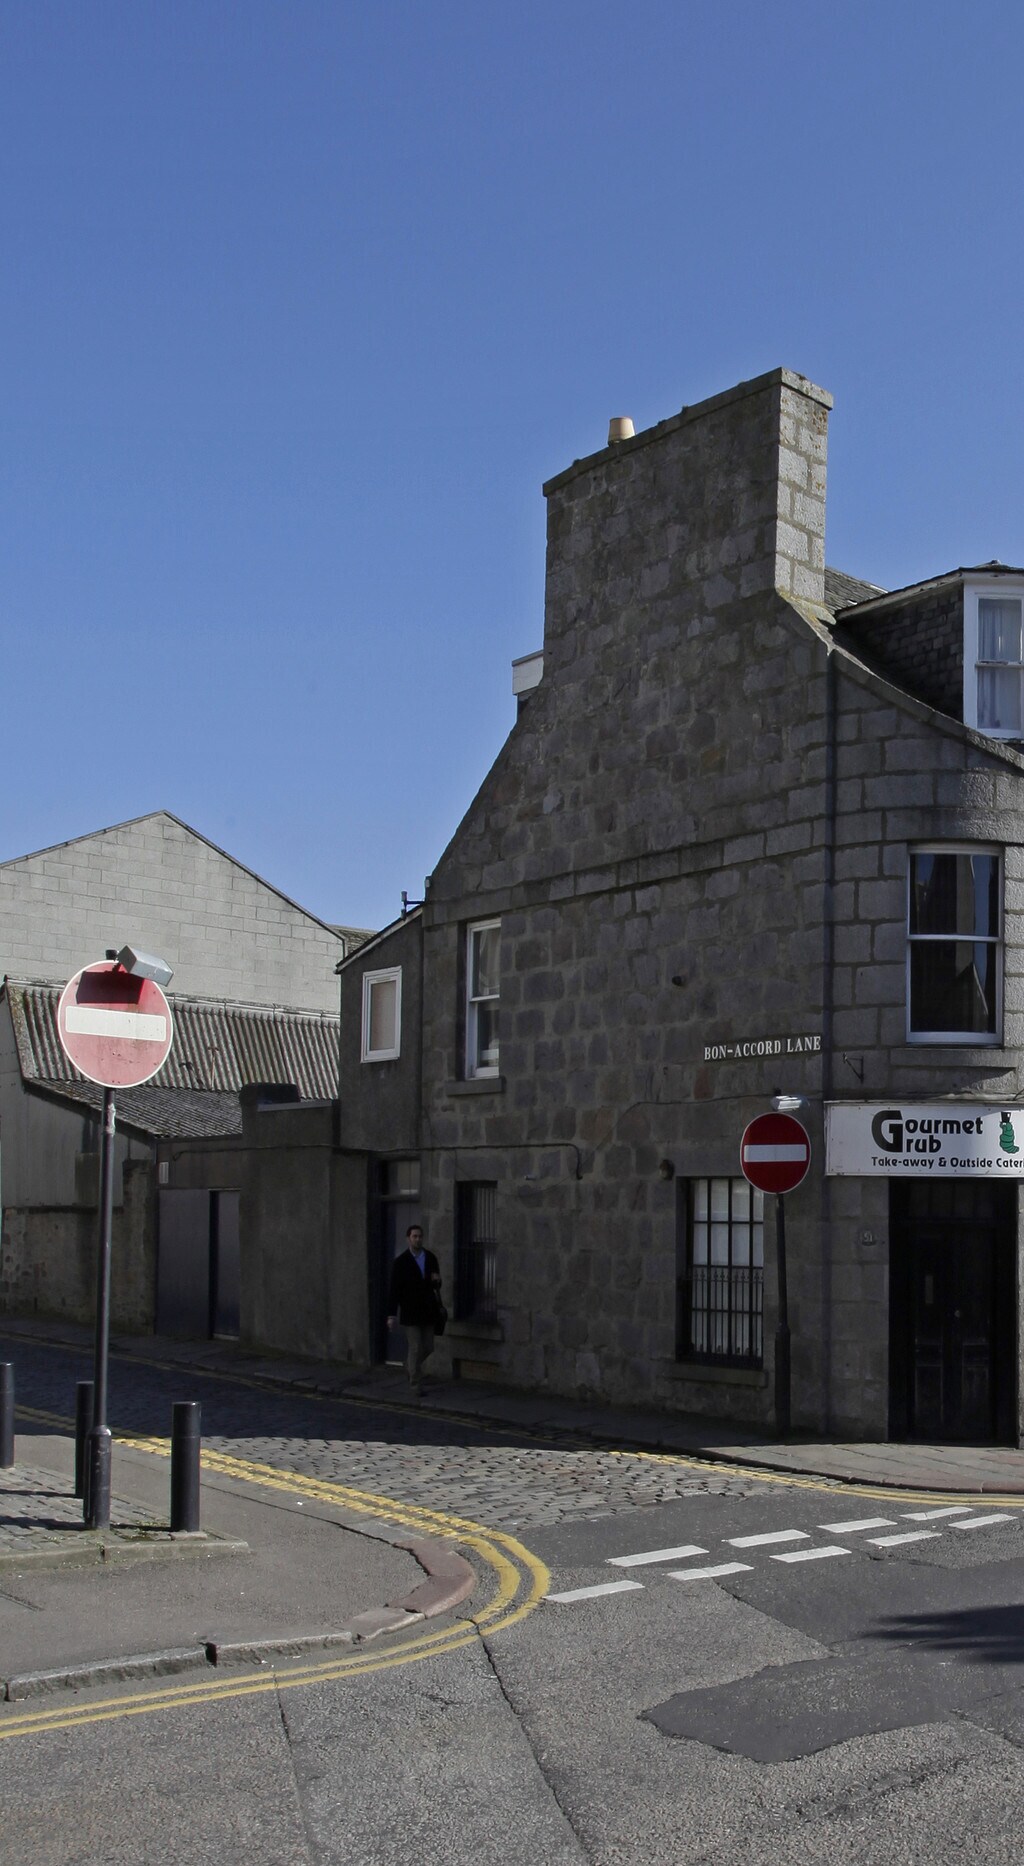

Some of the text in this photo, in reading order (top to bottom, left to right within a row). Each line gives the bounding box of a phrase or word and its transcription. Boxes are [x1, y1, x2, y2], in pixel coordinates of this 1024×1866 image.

[704, 1036, 821, 1060] BON-ACCORD LANE
[871, 1110, 983, 1153] Gourmet
[871, 1157, 934, 1169] Take-away
[938, 1157, 947, 1167] &
[950, 1157, 993, 1168] Outside
